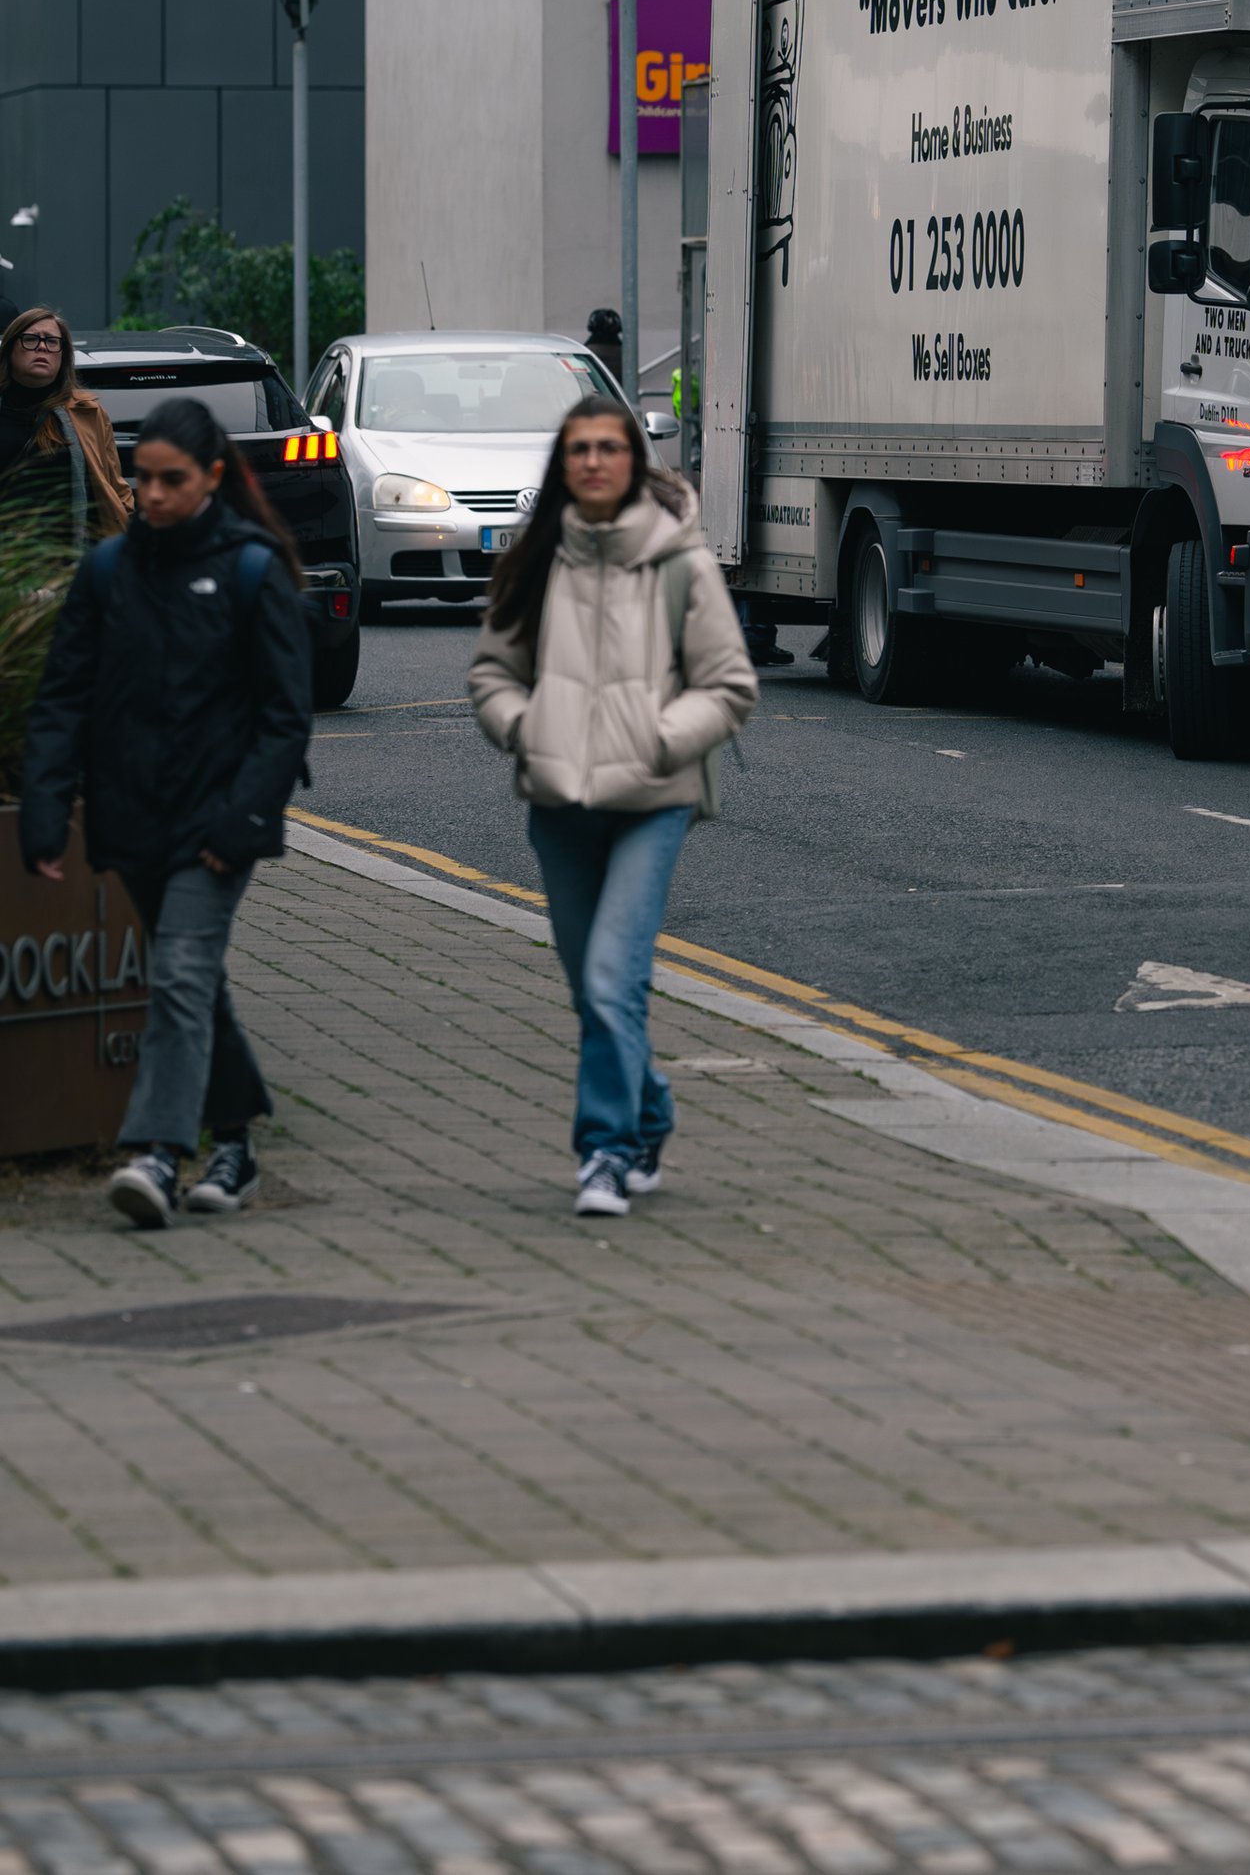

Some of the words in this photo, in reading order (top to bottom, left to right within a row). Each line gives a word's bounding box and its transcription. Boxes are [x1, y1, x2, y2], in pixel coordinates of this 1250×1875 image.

[636, 50, 711, 102] Gir
[911, 112, 949, 164] Home
[952, 105, 961, 157] &
[963, 104, 1012, 156] Business
[889, 218, 915, 294] 01
[926, 213, 964, 292] 253
[972, 208, 1024, 290] 0000
[1204, 306, 1224, 330] TWO
[1227, 309, 1247, 332] MEN
[912, 333, 931, 381] We
[933, 332, 954, 381] Sell
[957, 332, 991, 381] Boxes
[1195, 333, 1212, 355] AND
[1215, 335, 1221, 356] A
[1200, 402, 1220, 422] Dublin
[0, 926, 153, 1000] OCKLA
